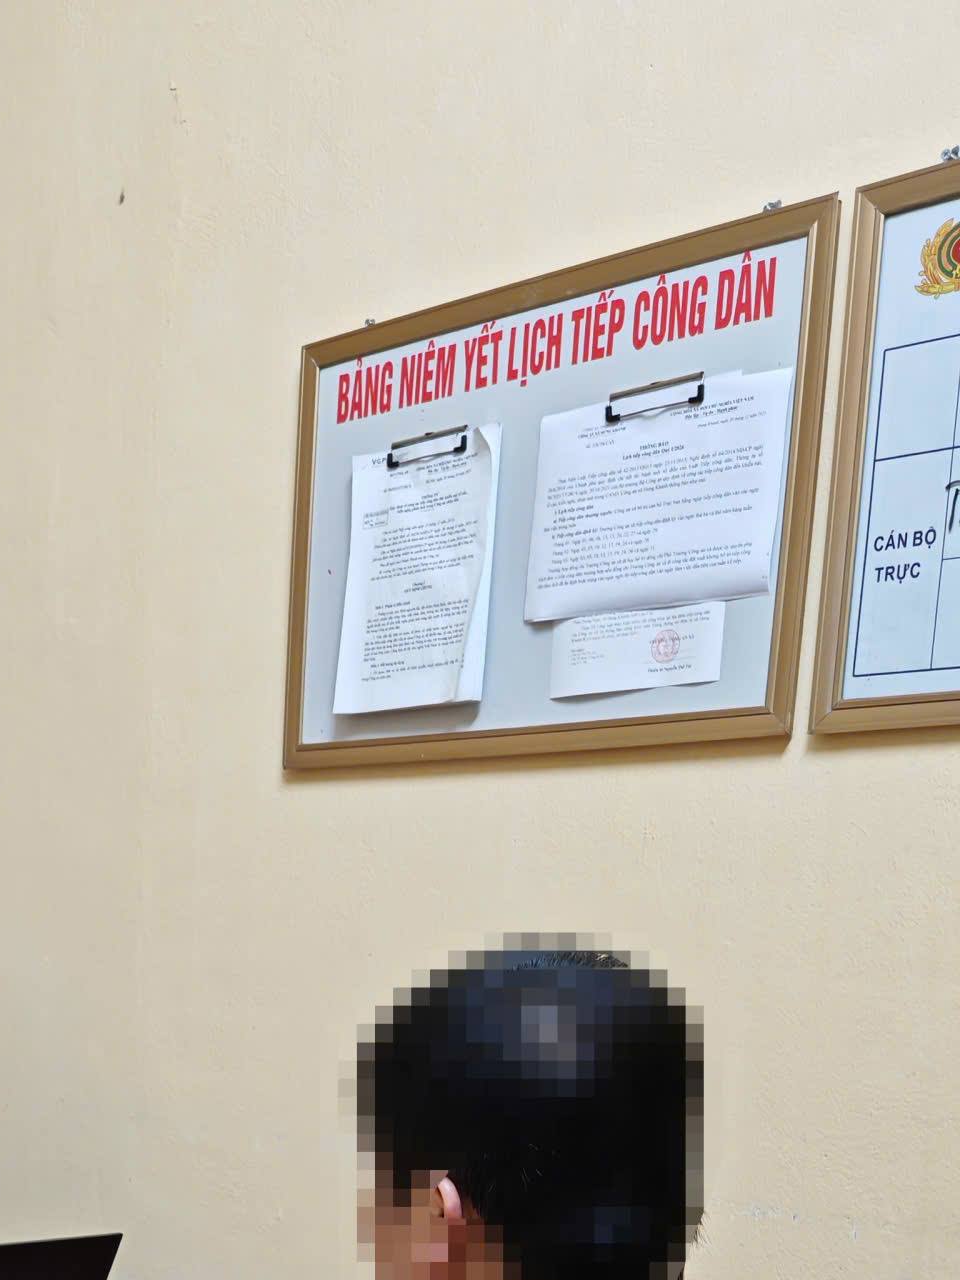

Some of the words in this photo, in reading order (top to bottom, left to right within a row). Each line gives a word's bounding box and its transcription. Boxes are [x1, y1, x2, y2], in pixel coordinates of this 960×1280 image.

[336, 355, 393, 424] BẢNG
[399, 338, 457, 407] NIÊM
[464, 318, 504, 392] YẾT
[507, 313, 563, 387] LỊCH
[571, 289, 626, 364] TIẾP
[633, 273, 708, 350] CÔNG
[715, 249, 778, 330] DÂN
[873, 529, 909, 552] CÁN
[911, 526, 937, 550] BỘ
[874, 561, 921, 584] TRỰC
